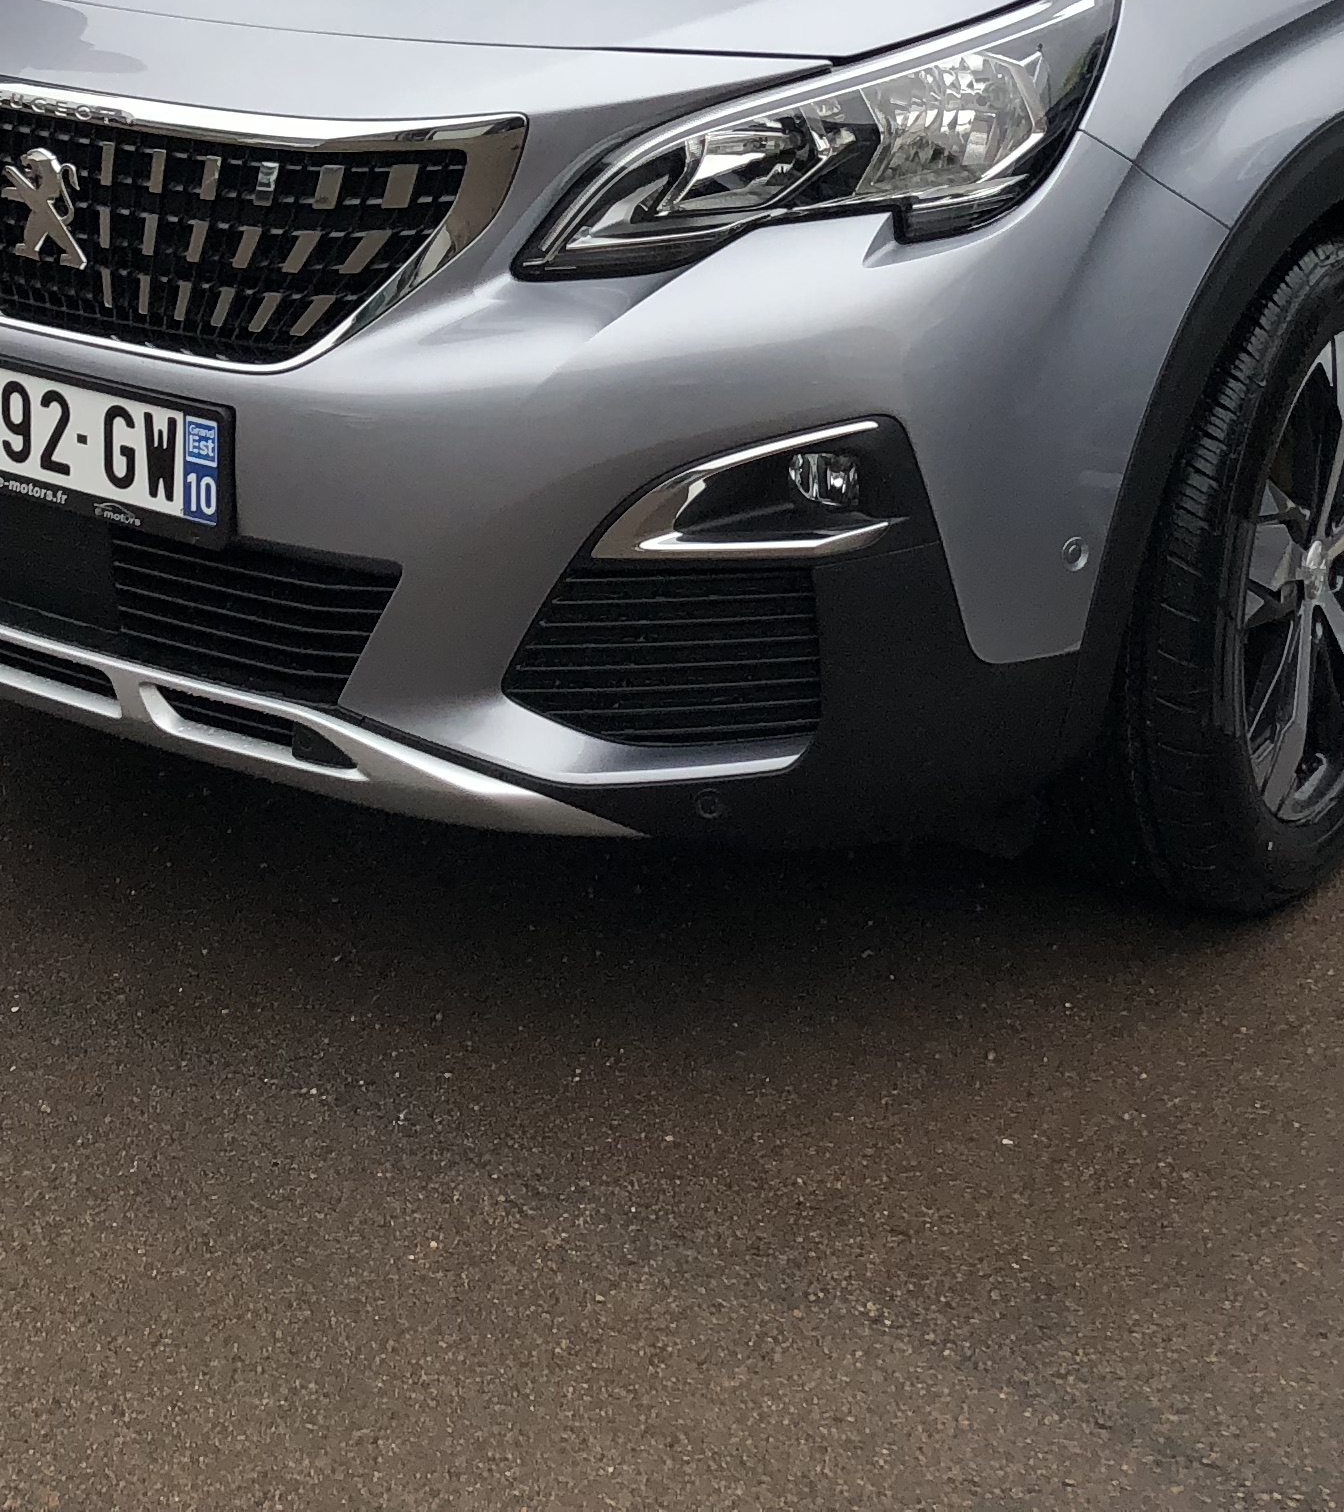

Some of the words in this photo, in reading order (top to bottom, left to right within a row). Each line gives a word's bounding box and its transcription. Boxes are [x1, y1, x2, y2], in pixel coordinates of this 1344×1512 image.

[188, 424, 215, 439] Grand
[188, 434, 215, 457] Est
[186, 472, 217, 515] 10
